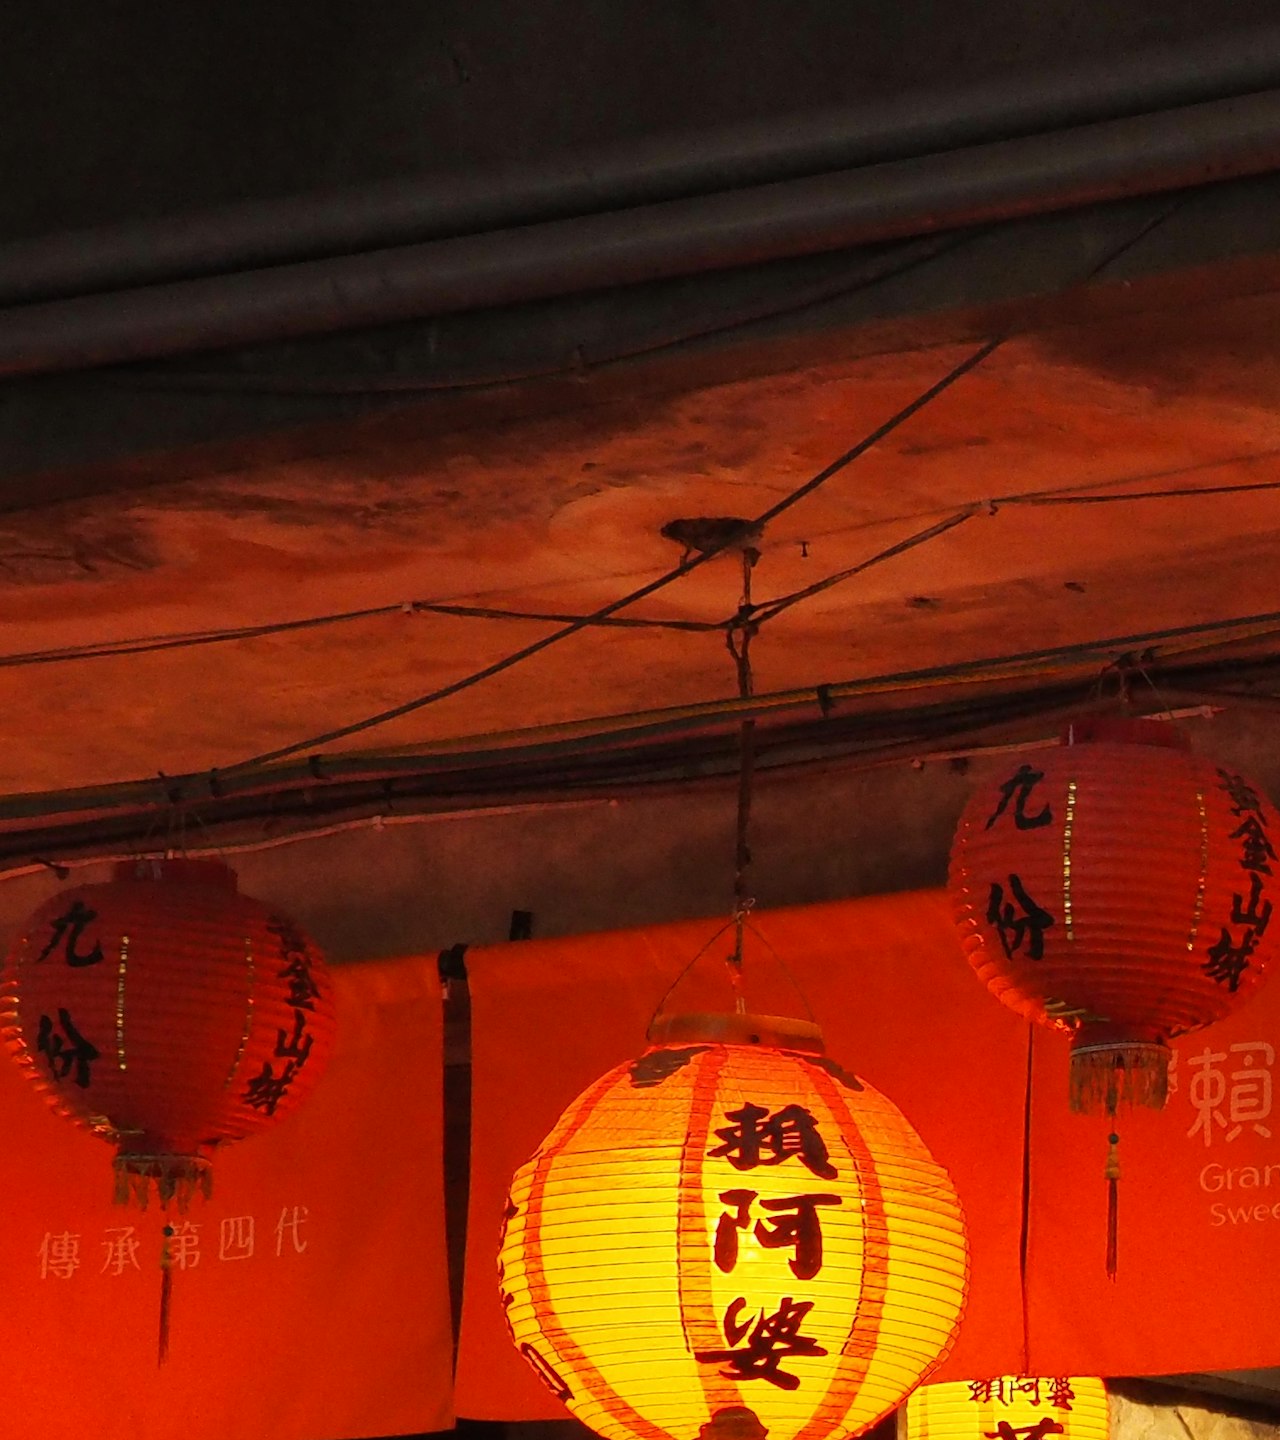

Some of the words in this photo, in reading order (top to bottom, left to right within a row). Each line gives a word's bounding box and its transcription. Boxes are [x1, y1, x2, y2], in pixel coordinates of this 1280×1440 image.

[985, 765, 1054, 960] 九份
[36, 901, 104, 1088] 九份
[37, 1206, 309, 1279] 傳承第四代
[694, 1103, 842, 1391] 賴阿婆
